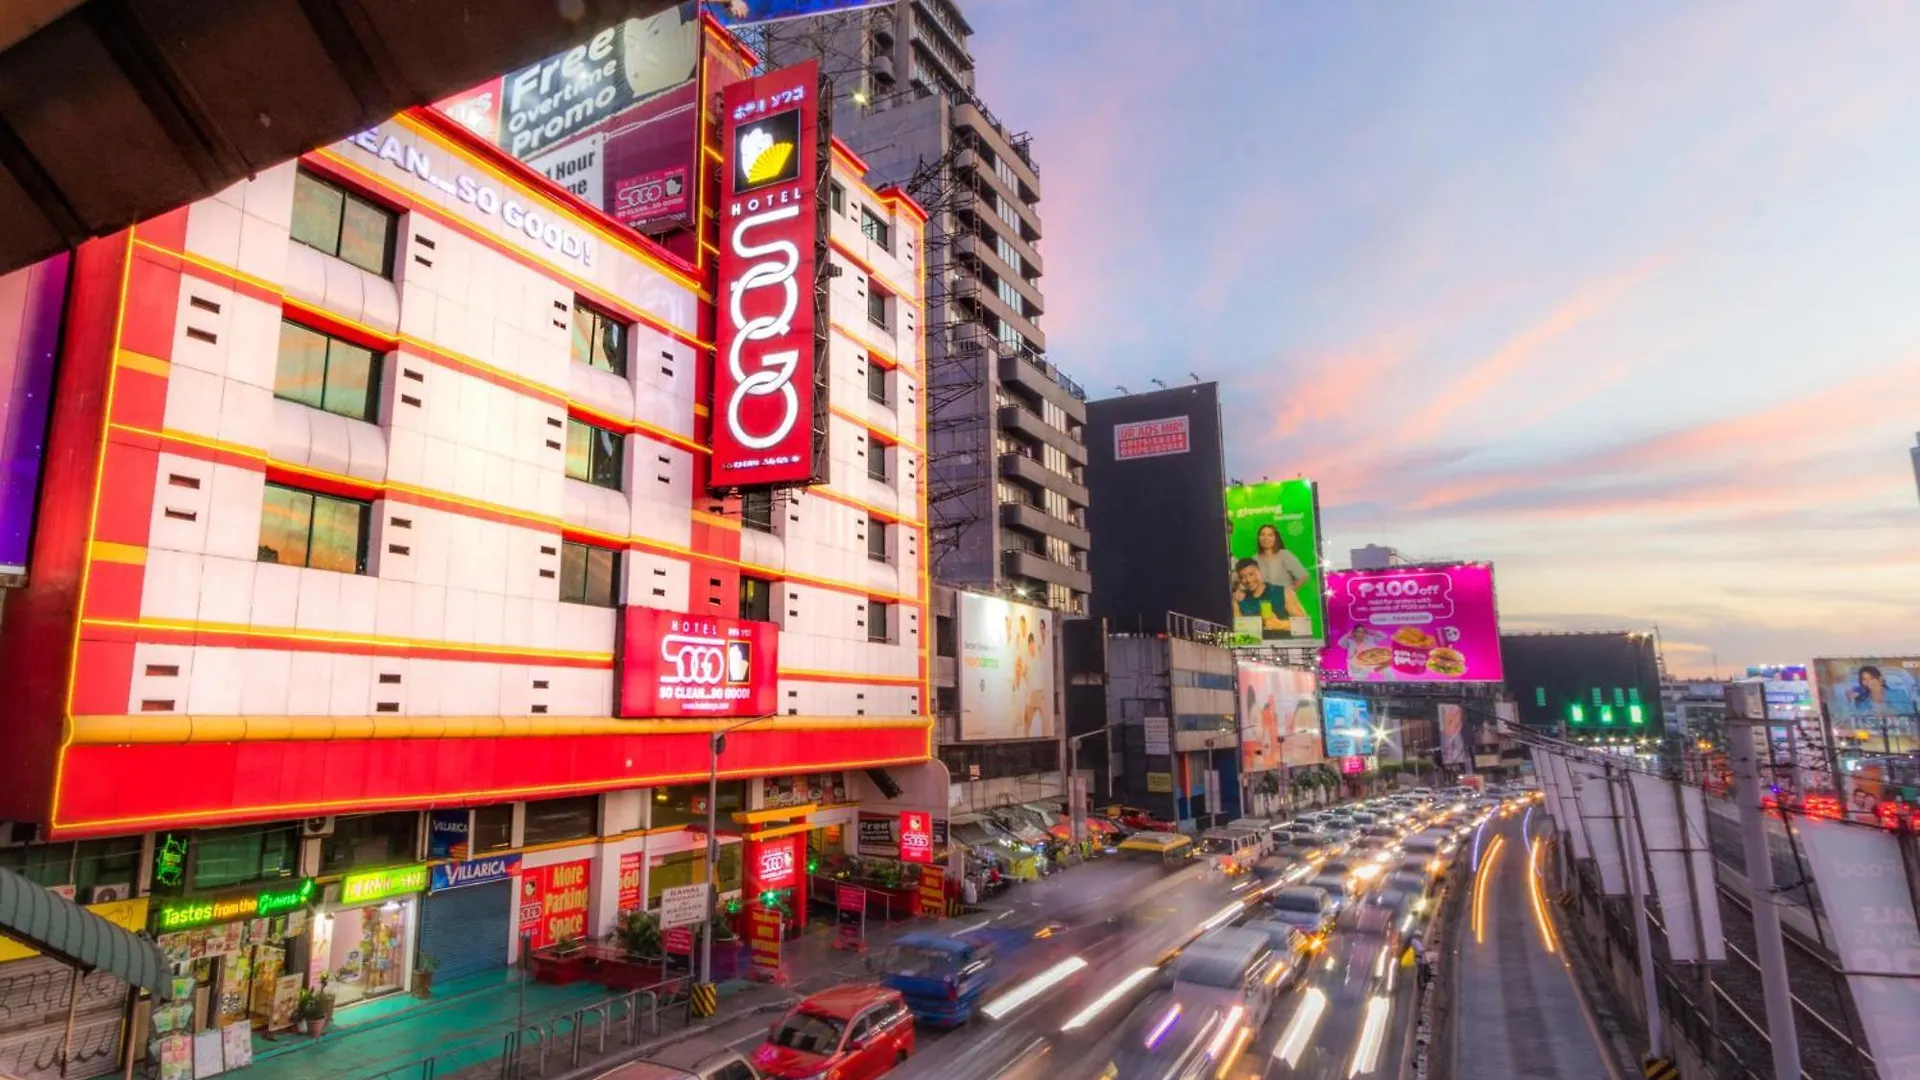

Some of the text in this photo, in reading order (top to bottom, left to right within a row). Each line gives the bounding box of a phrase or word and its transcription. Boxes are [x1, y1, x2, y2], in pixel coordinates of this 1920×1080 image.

[511, 27, 615, 113] Free
[509, 60, 617, 132] Overtime
[512, 85, 617, 158] Promo
[556, 151, 595, 180] Hour
[732, 188, 801, 216] HOTEL
[501, 199, 592, 267] GOOD!
[728, 206, 799, 449] SOGO
[1419, 584, 1440, 596] off
[671, 620, 717, 636] HOTEL
[660, 634, 726, 684] SOGO
[433, 821, 468, 833] VILLARICA
[445, 860, 506, 885] VILLARICA
[552, 865, 584, 889] More
[164, 904, 212, 926] Tastes
[213, 902, 238, 916] from
[240, 899, 257, 913] the
[545, 886, 588, 915] Parking
[549, 914, 583, 942] Space
